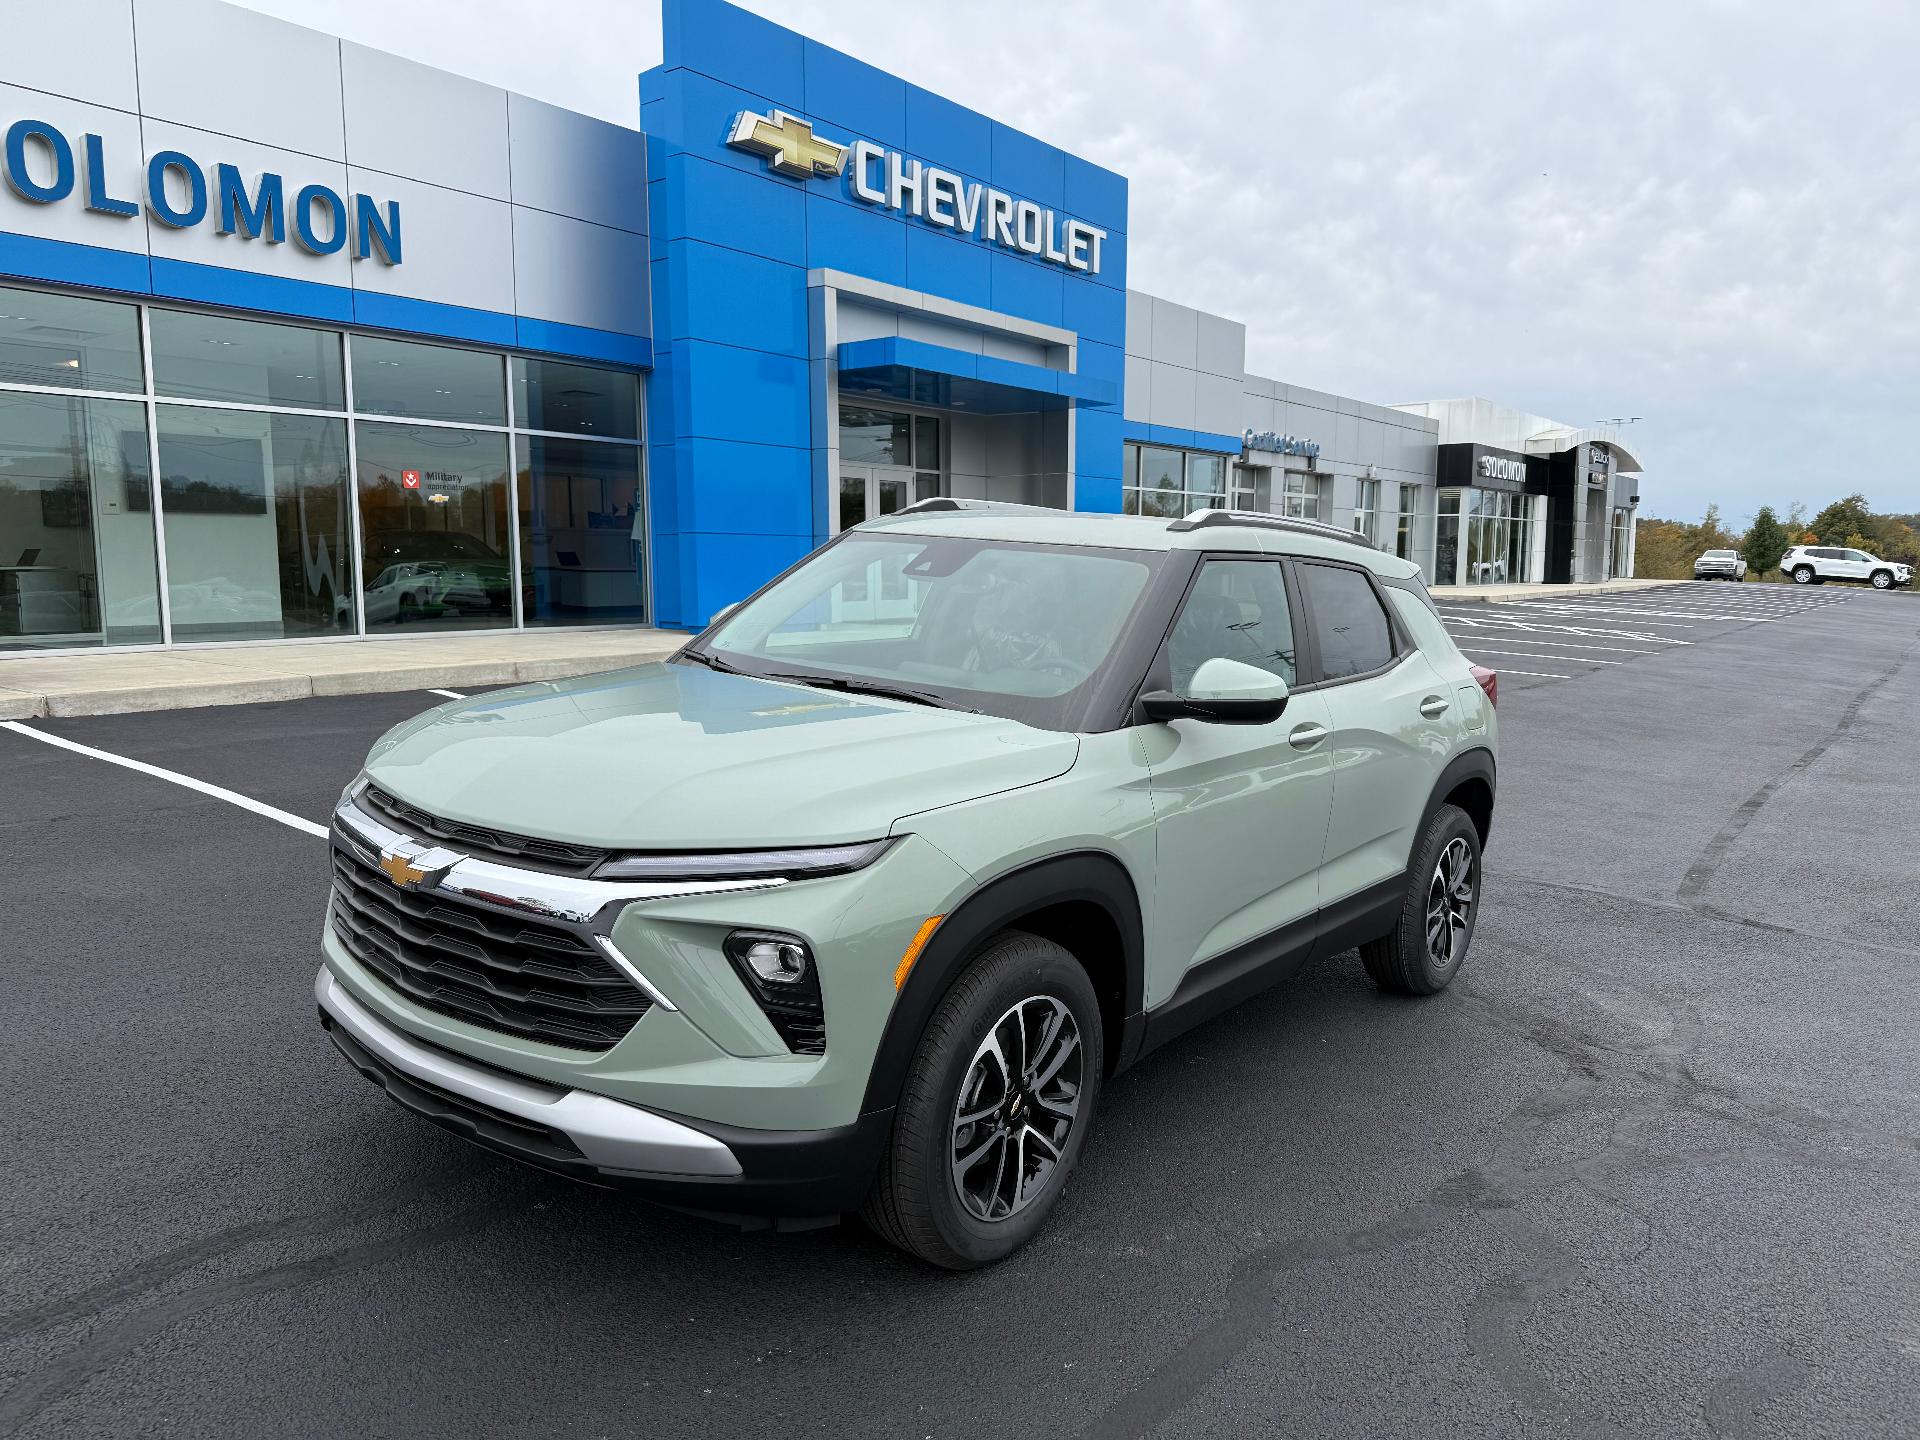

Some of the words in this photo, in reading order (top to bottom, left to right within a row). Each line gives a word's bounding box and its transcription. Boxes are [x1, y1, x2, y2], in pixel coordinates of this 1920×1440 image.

[2, 119, 402, 266] OLOMON
[849, 139, 1107, 274] CHEVROLET
[426, 471, 463, 483] Military
[1482, 455, 1527, 482] SOLOMON
